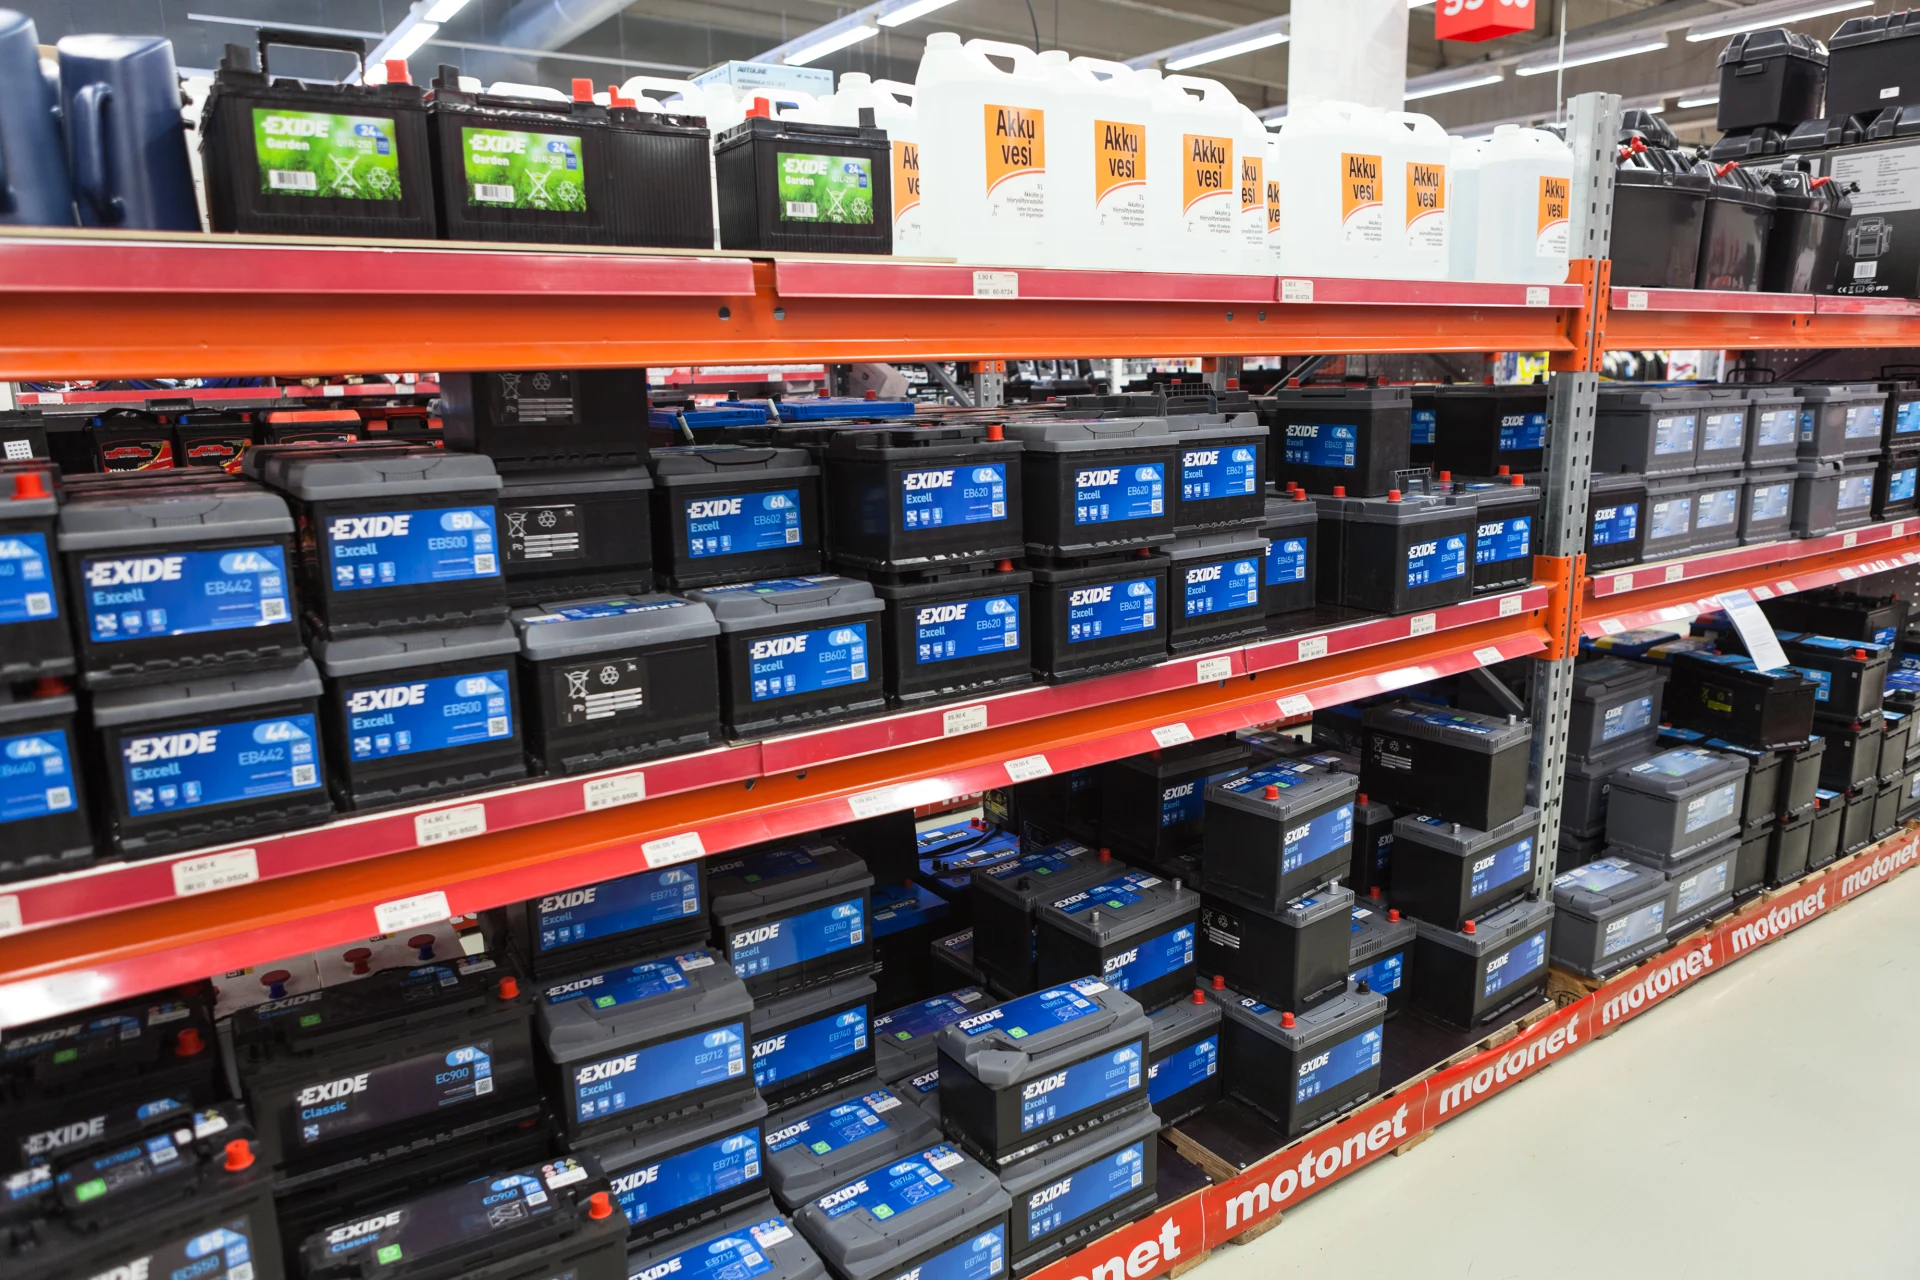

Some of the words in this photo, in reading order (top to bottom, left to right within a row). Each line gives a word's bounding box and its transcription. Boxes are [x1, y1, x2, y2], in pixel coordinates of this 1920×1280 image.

[261, 116, 329, 137] EXIDE
[996, 110, 1035, 139] Akku
[266, 138, 309, 150] Garden
[468, 134, 526, 154] EXIDE
[1104, 125, 1138, 152] Akku
[1002, 140, 1032, 166] vesi
[1192, 139, 1224, 164] Akku
[472, 154, 509, 166] Garden
[783, 158, 828, 175] EXIDE
[1109, 146, 1135, 178] vesi
[1349, 156, 1376, 178] Akku
[1197, 162, 1222, 188] vesi
[1414, 166, 1438, 188] Akku
[1242, 179, 1256, 203] esi
[1353, 180, 1374, 200] vesi
[1545, 180, 1565, 198] Akku
[1416, 189, 1436, 207] vesi
[1547, 201, 1562, 217] vesi
[1286, 424, 1319, 438] EXIDE
[1183, 450, 1220, 467] EXIDE
[979, 470, 992, 482] 62
[1076, 469, 1120, 487] EXIDE
[1141, 468, 1153, 480] 62
[1227, 466, 1243, 476] EB621
[903, 470, 954, 490] EXIDE
[906, 492, 932, 504] Excell
[964, 487, 988, 498] EB620
[1128, 486, 1148, 495] EB620
[687, 498, 742, 519] EXIDE
[770, 497, 785, 508] 60
[329, 515, 410, 540] EXIDE
[452, 514, 473, 529] 50
[691, 520, 720, 533] Excell
[754, 514, 780, 526] EB602
[335, 543, 377, 558] Excell
[428, 536, 467, 550] EB500
[513, 543, 523, 551] Pb
[1408, 542, 1437, 558] EXIDE
[232, 554, 257, 572] 44
[1278, 556, 1294, 565] EB454
[85, 557, 183, 587] EXIDE
[1186, 566, 1222, 584] EXIDE
[205, 580, 252, 596] EB442
[1229, 579, 1246, 589] EB621
[93, 589, 145, 606] Excell
[1070, 586, 1112, 605] EXIDE
[992, 601, 1005, 613] 62
[1071, 608, 1093, 619] Excell
[1120, 600, 1140, 611] EB620
[917, 605, 967, 624] EXIDE
[919, 626, 945, 638] Excell
[976, 619, 1001, 630] EB620
[836, 630, 850, 643] 60
[751, 635, 807, 659] EXIDE
[819, 649, 846, 663] EB602
[754, 660, 783, 674] Excell
[1810, 671, 1822, 680] 105
[466, 679, 486, 694] 50
[347, 684, 425, 713] EXIDE
[443, 701, 481, 717] EB500
[573, 704, 585, 713] Pb
[353, 714, 394, 730] Excell
[963, 721, 982, 731] 90-9507
[265, 722, 289, 740] 44
[124, 730, 218, 763] EXIDE
[238, 749, 284, 765] EB442
[132, 763, 181, 782] Excell
[1163, 783, 1195, 800] EXIDE
[1284, 823, 1311, 845] EXIDE
[1842, 835, 1920, 897] motonet
[668, 871, 680, 882] 71
[538, 887, 596, 912] EXIDE
[650, 887, 678, 901] EB712
[1054, 892, 1089, 909] EXIDE
[542, 912, 572, 925] Excell
[1732, 883, 1826, 953] motonet
[824, 921, 847, 934] EB740
[732, 924, 780, 948] EXIDE
[734, 947, 760, 960] Excell
[1167, 944, 1183, 956] EB704
[1104, 948, 1138, 972] EXIDE
[627, 971, 656, 983] EB712
[1379, 972, 1393, 982] EB954
[1602, 943, 1713, 1026] motonet
[546, 976, 604, 996] EXIDE
[1041, 999, 1065, 1009] EB802
[960, 1009, 1003, 1029] EXIDE
[829, 1029, 850, 1042] EB740
[968, 1023, 993, 1034] Excell
[712, 1032, 726, 1044] 71
[753, 1035, 786, 1058] XIDE
[694, 1049, 723, 1065] EB712
[1118, 1051, 1130, 1062] 80
[1189, 1057, 1205, 1069] EB704
[1298, 1052, 1330, 1076] EXIDE
[1439, 1012, 1579, 1114] motonet
[576, 1054, 638, 1084] EXIDE
[1105, 1066, 1126, 1079] EB802
[1023, 1072, 1066, 1099] EXIDE
[1299, 1073, 1316, 1087] Excell
[297, 1073, 371, 1106] EXIDE
[580, 1081, 612, 1097] Excell
[302, 1101, 347, 1120] Classic
[1024, 1096, 1048, 1110] Excell
[829, 1114, 853, 1128] EB740
[730, 1137, 743, 1149] 71
[771, 1137, 797, 1152] Excell
[713, 1154, 740, 1172] EB712
[1224, 1104, 1407, 1230] motonet
[889, 1173, 915, 1189] EB740
[1108, 1166, 1129, 1181] EB802
[818, 1180, 868, 1210] EXIDE
[1029, 1178, 1073, 1208] EXIDE
[828, 1200, 857, 1216] Excell
[1031, 1203, 1053, 1219] Excell
[327, 1211, 400, 1243] EXIDE
[332, 1232, 380, 1252] Classic
[718, 1240, 730, 1251] 71
[979, 1233, 991, 1245] 74
[705, 1250, 735, 1268] EB712
[965, 1252, 987, 1268] EB740
